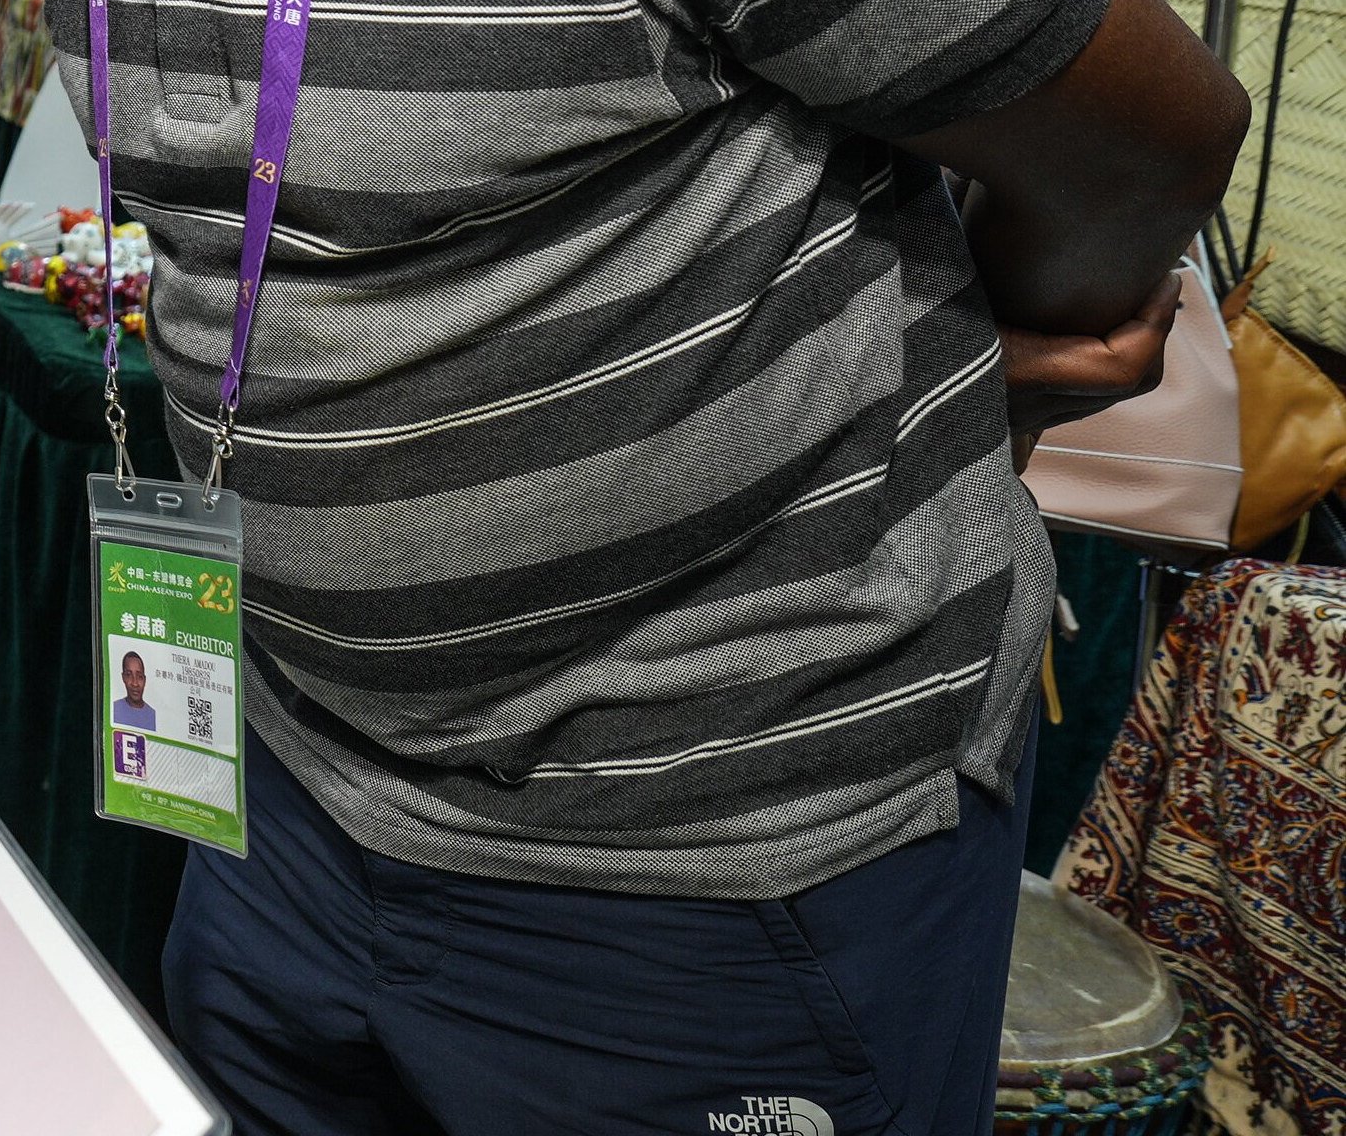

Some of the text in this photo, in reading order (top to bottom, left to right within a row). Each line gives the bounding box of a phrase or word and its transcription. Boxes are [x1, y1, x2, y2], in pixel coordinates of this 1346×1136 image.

[253, 158, 276, 184] 23
[175, 592, 193, 600] EXPO
[197, 572, 234, 614] 23
[120, 612, 166, 639] 参展商
[176, 631, 234, 657] EXHIBITOR
[740, 1096, 790, 1115] THE
[707, 1112, 792, 1133] NORTH
